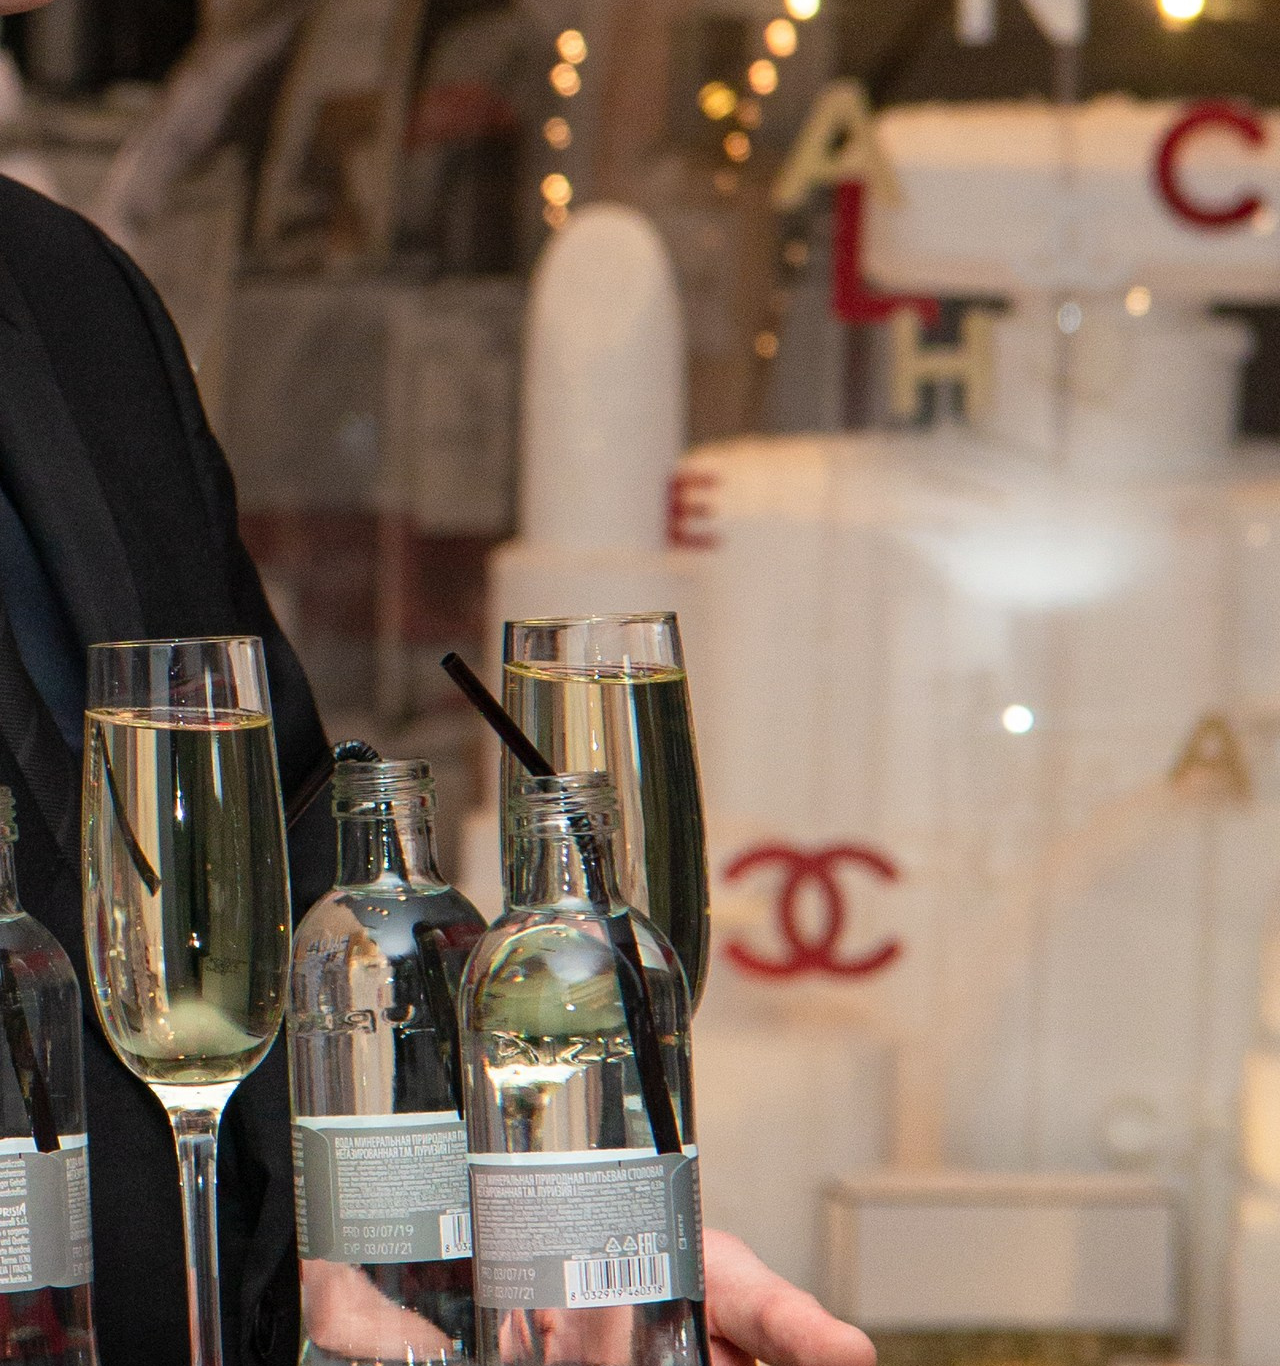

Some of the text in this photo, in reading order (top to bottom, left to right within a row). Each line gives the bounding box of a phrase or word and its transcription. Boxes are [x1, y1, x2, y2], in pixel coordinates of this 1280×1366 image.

[772, 79, 908, 209] A
[1155, 97, 1269, 230] C
[832, 180, 942, 325] L
[889, 310, 999, 416] H
[666, 471, 721, 551] E
[354, 1134, 411, 1148] МИНЕРАЛЬНАЯ
[412, 1131, 456, 1146] ПРИРОДНАЯ
[535, 1172, 585, 1186] ПРИРОДНАЯ
[585, 1169, 627, 1184] ПИТЬЕВАЯ
[363, 1225, 414, 1238] 03/07/19
[364, 1242, 412, 1255] 03/07/21
[494, 1267, 536, 1281] 03/07/19
[570, 1286, 663, 1301] 8 032919 460318
